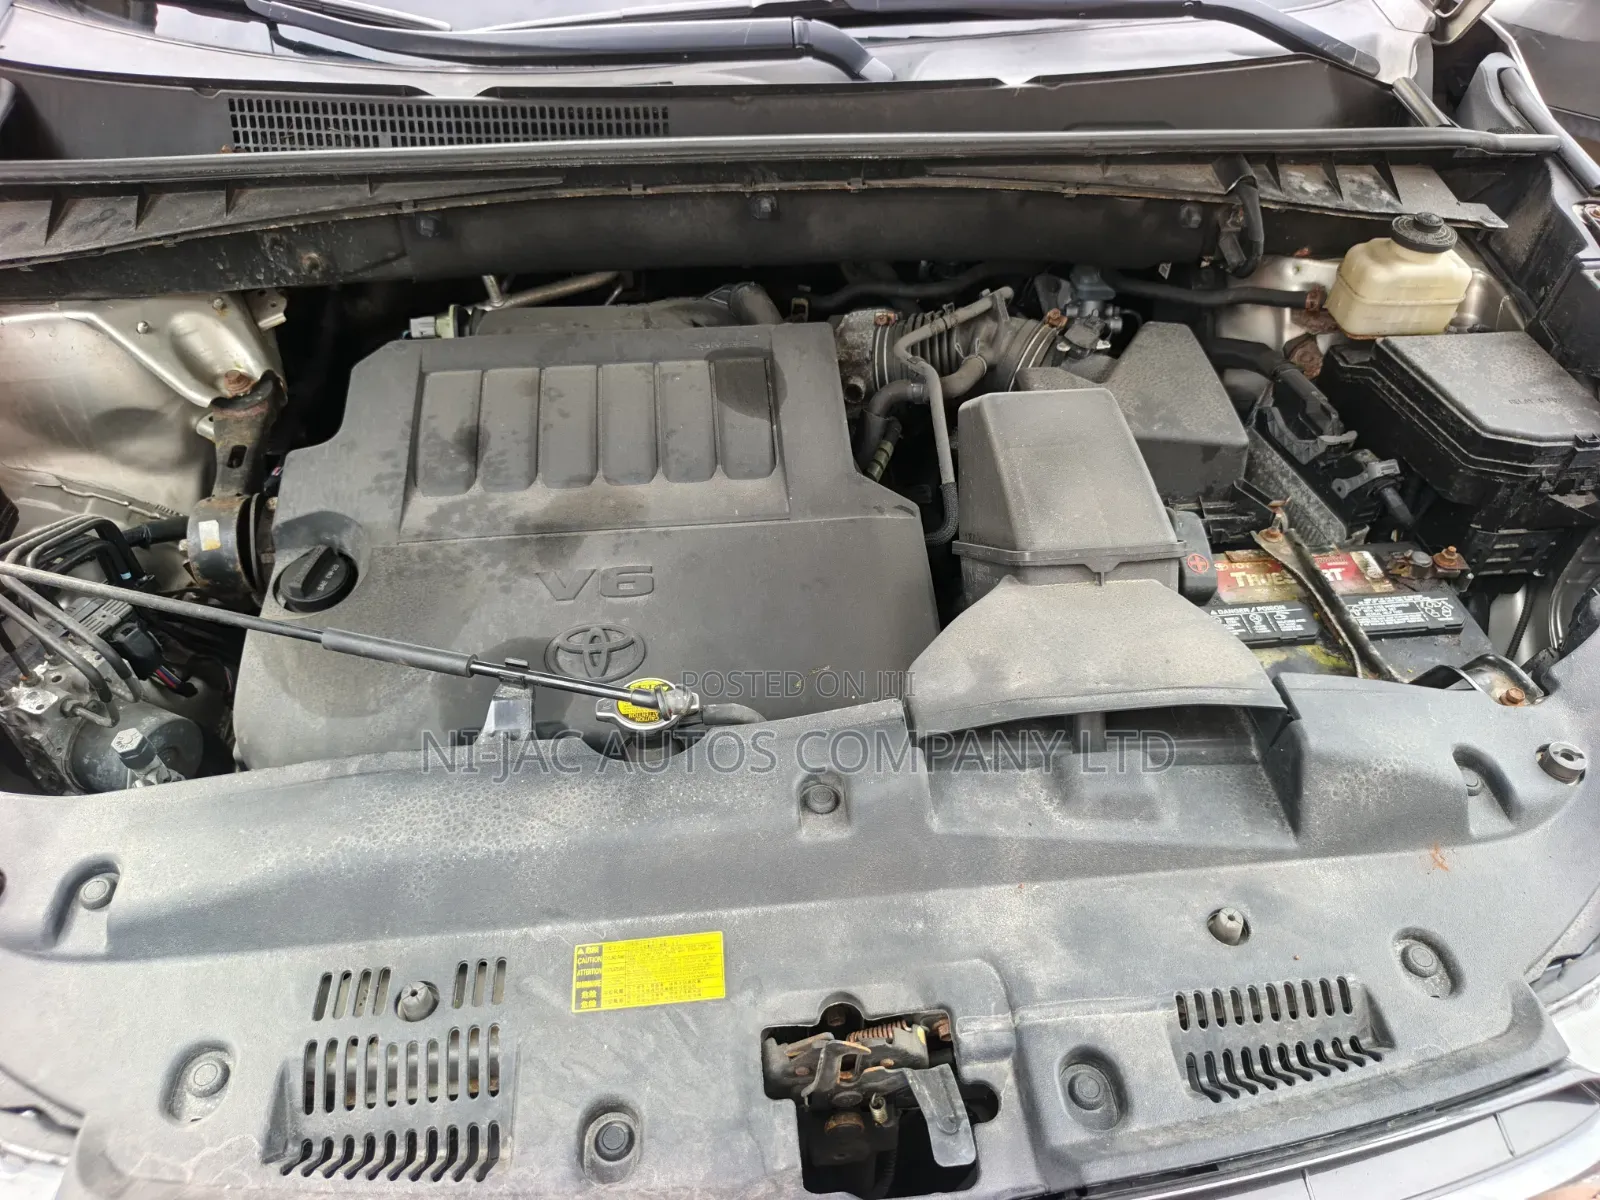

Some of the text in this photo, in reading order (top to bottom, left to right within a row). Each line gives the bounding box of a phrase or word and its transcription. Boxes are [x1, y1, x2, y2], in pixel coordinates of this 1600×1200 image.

[535, 566, 655, 602] V6
[577, 956, 602, 964] CAUTION
[576, 968, 602, 976] ATTENTION
